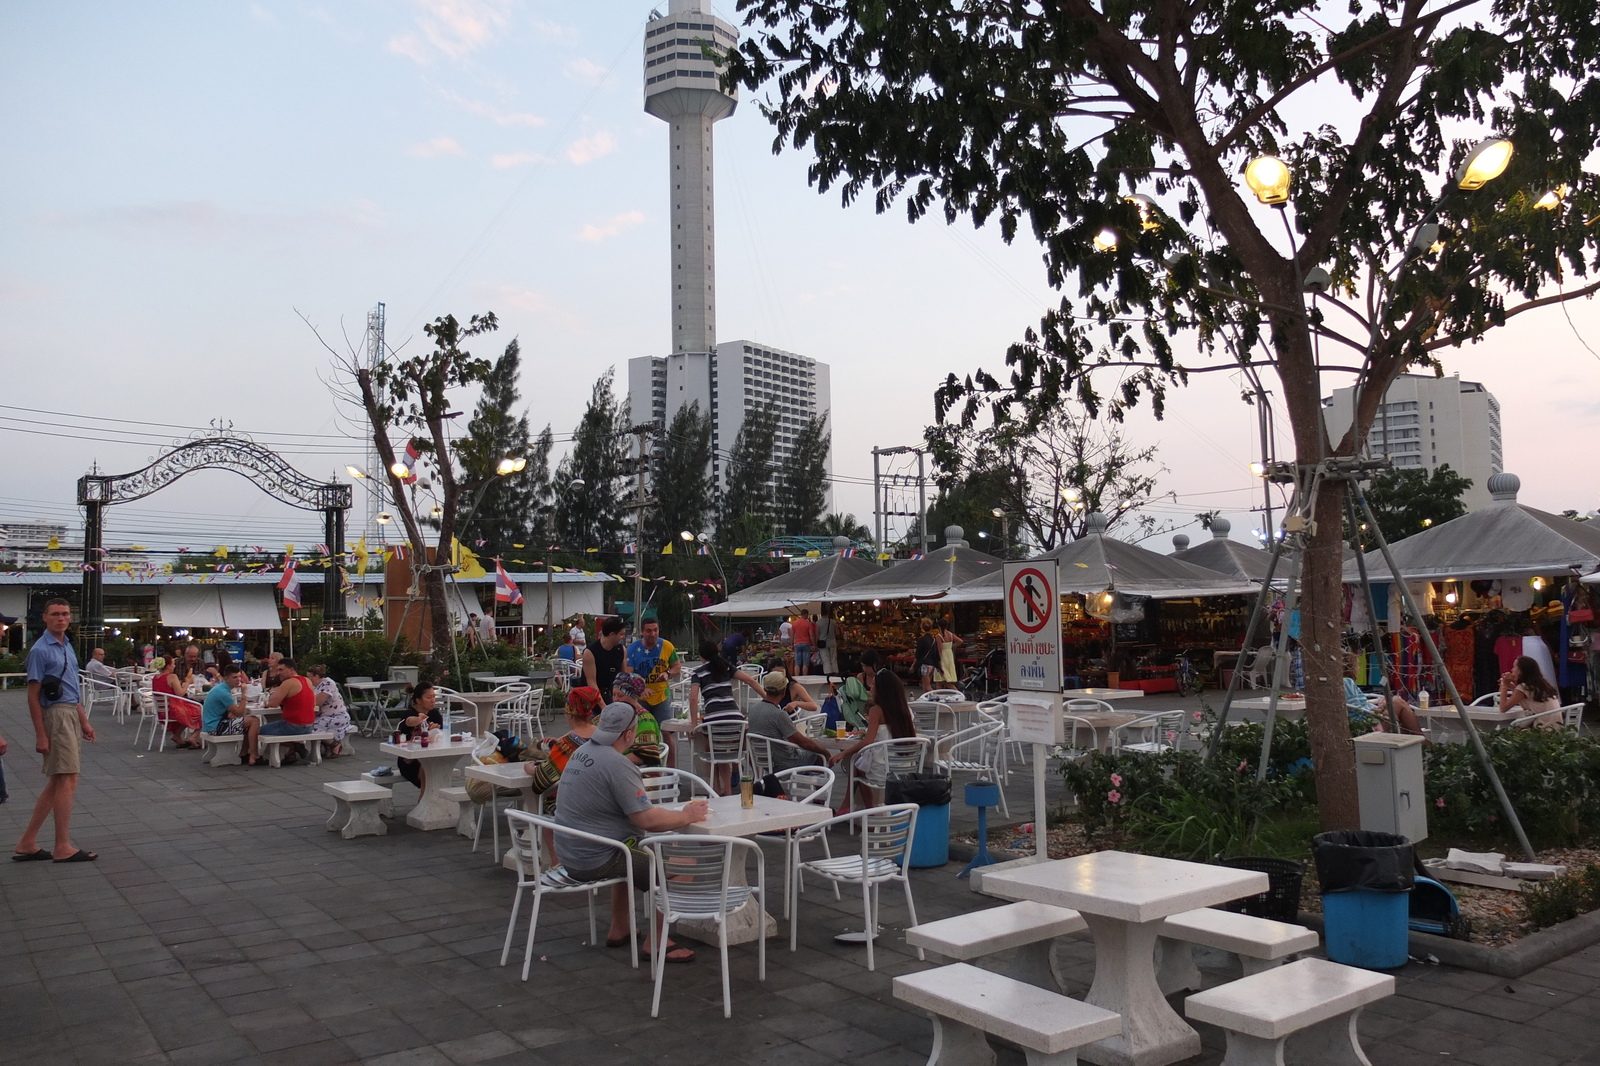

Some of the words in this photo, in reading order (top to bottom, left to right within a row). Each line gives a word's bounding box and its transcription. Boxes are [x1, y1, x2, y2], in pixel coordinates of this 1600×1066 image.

[1010, 634, 1056, 655] ห้ามทิ้งขยะ
[1020, 656, 1045, 679] ลงพื้น
